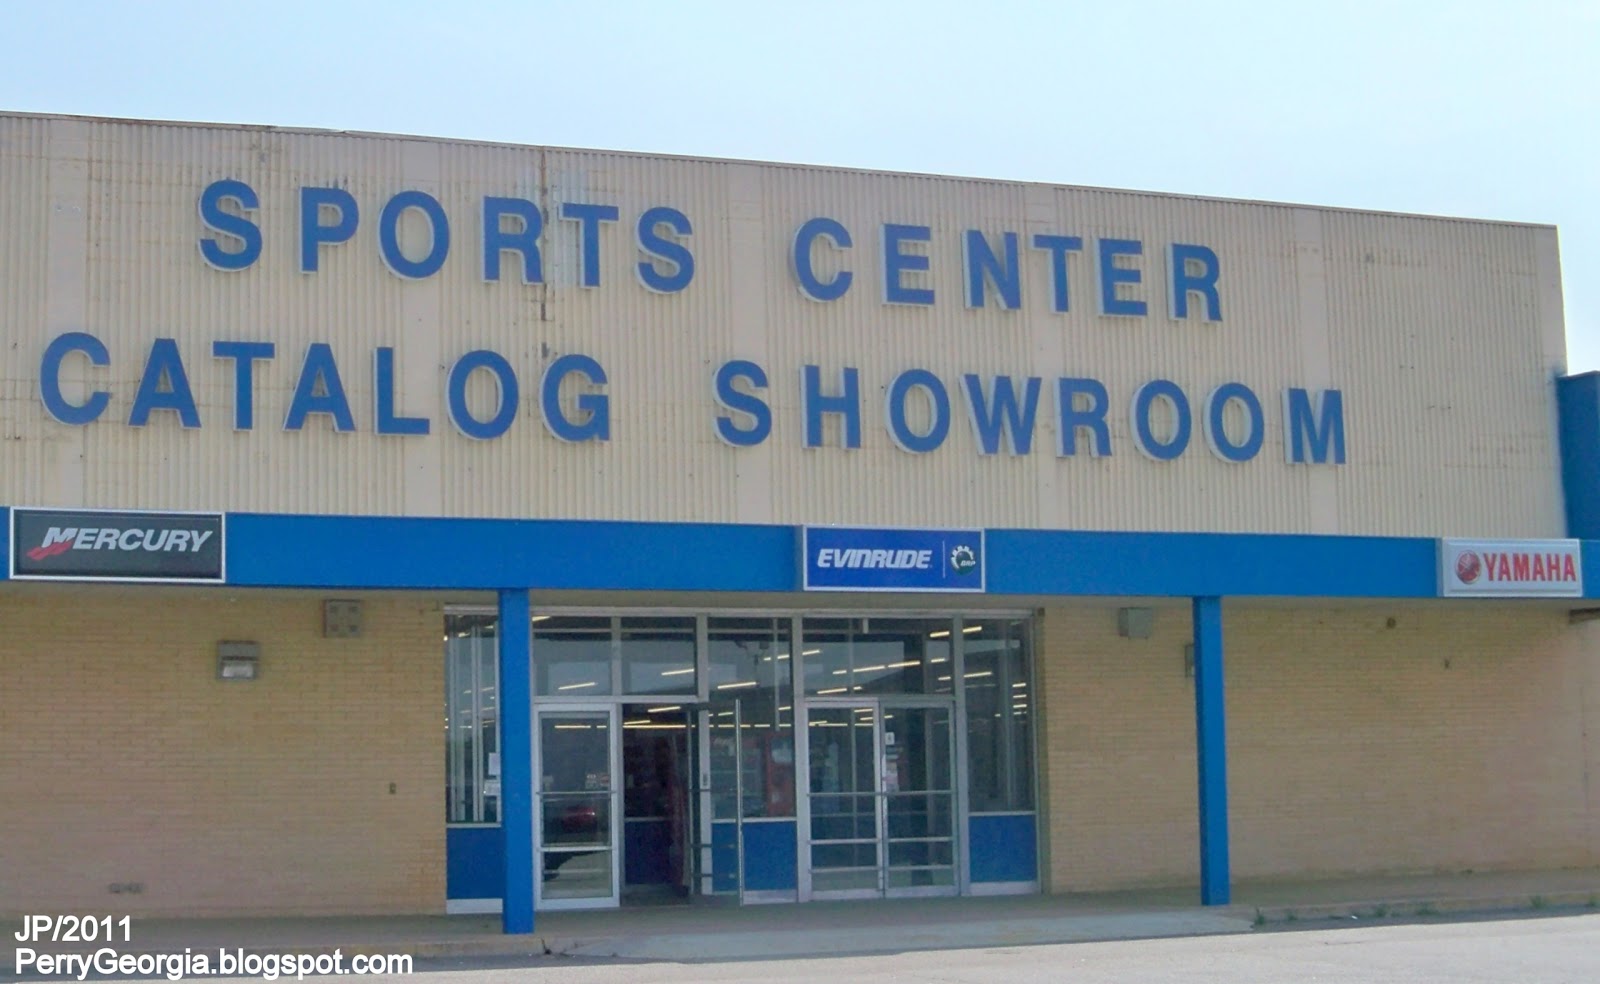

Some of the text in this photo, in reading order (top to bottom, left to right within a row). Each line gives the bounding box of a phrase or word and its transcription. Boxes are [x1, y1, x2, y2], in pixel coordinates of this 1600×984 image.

[200, 179, 1222, 322] SPORTS CENTER
[40, 332, 1346, 464] CATALOG SHOWROOM
[40, 526, 214, 553] MERCURY
[816, 548, 932, 569] EVINRUDE
[1483, 553, 1577, 581] YAMAHA
